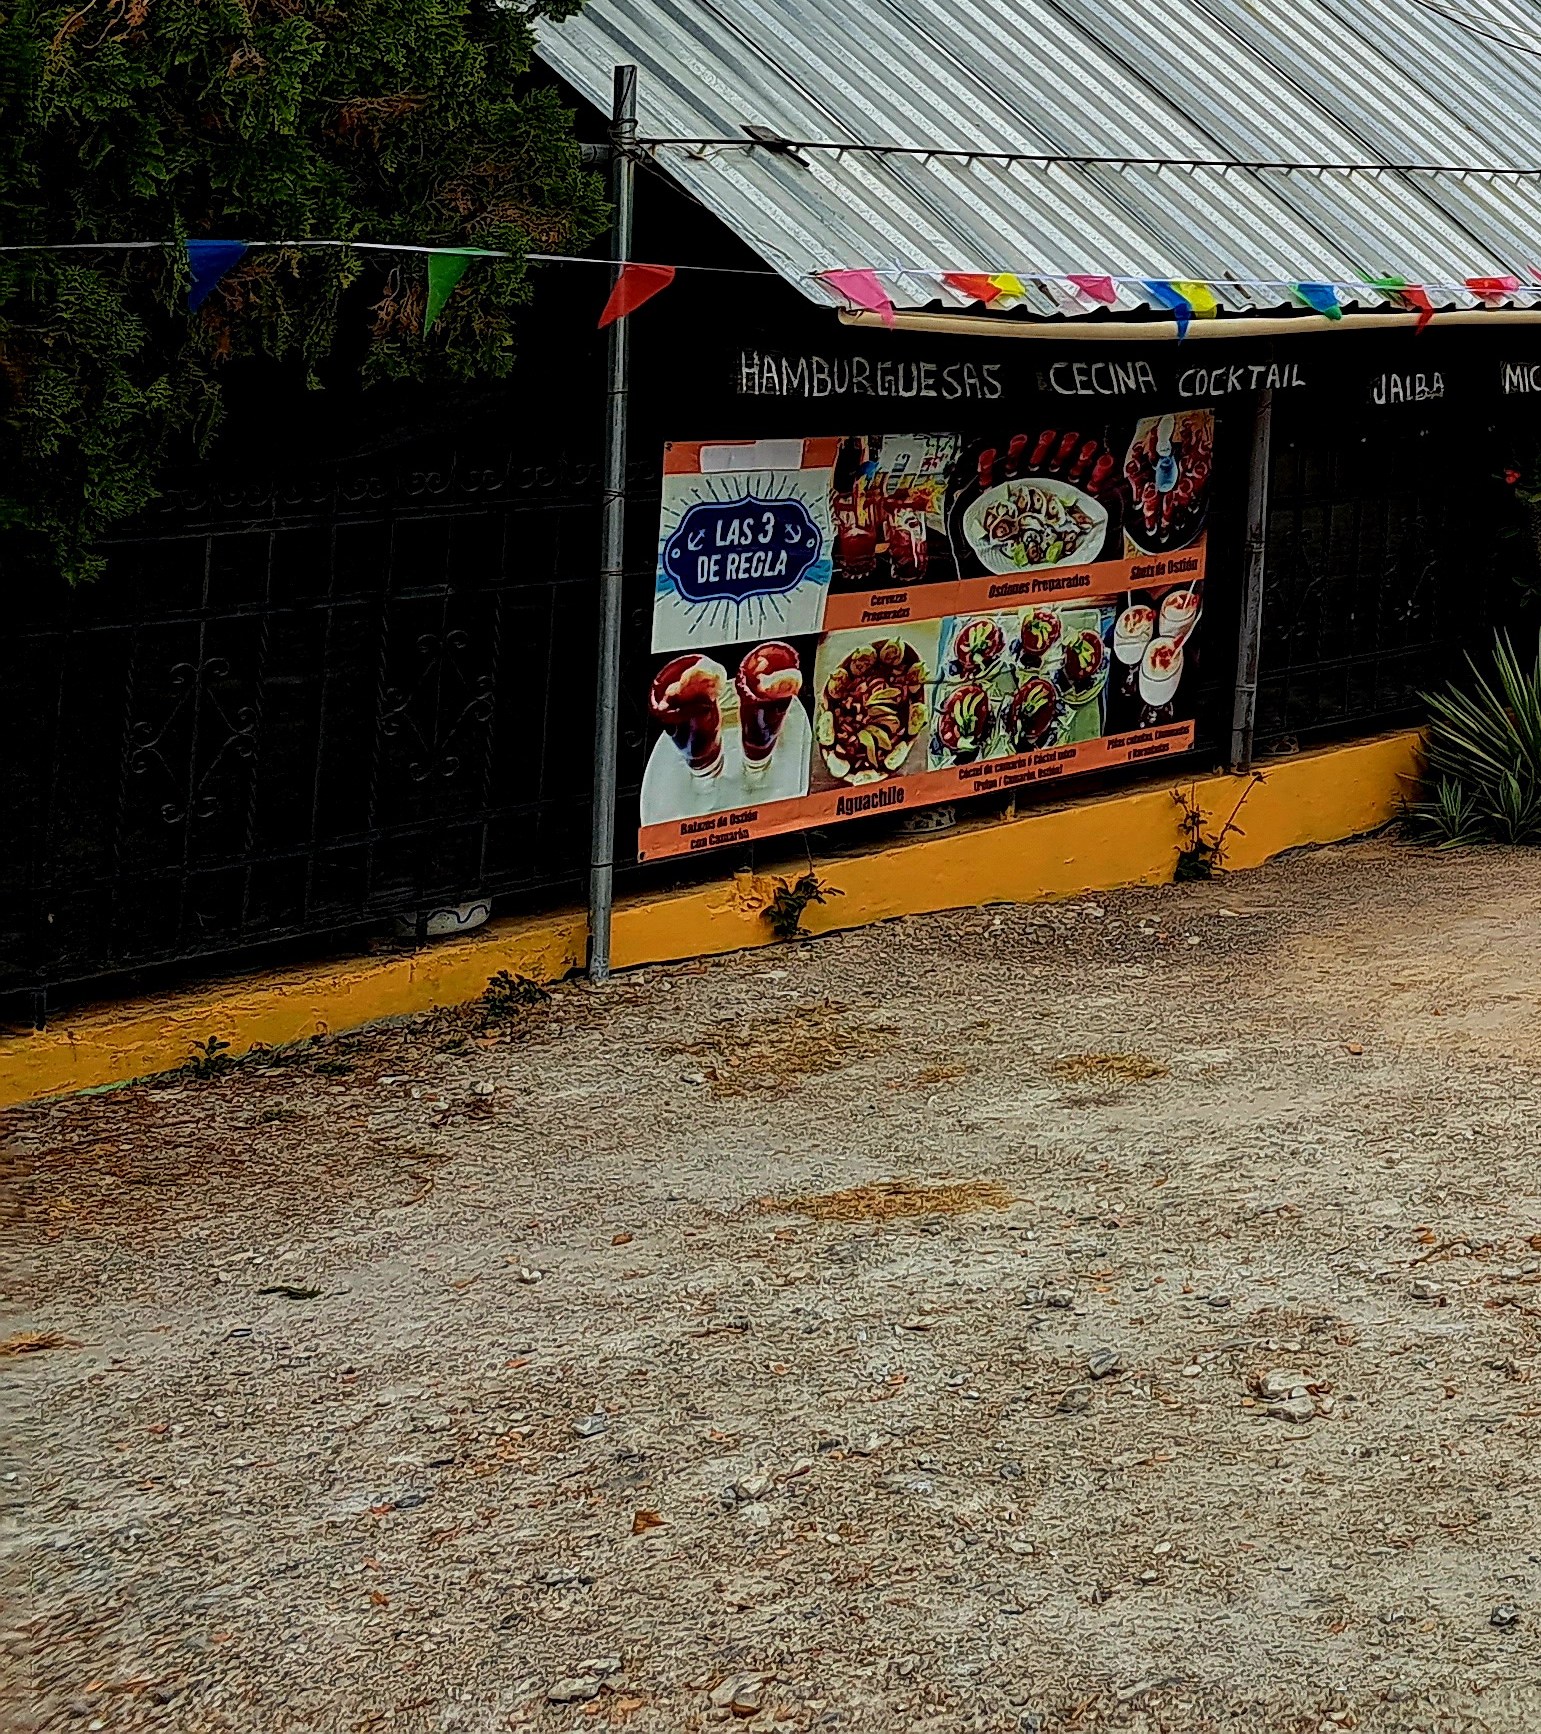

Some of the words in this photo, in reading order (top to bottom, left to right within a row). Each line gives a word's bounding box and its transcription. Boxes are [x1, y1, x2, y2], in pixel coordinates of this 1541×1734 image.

[741, 350, 1001, 399] HAMBURGUESAS
[1050, 361, 1158, 395] CECINA
[1178, 364, 1306, 397] COCKTAIL
[716, 518, 755, 546] LAS
[758, 512, 775, 543] 3
[697, 554, 721, 583] DE
[726, 549, 787, 580] REGLA
[1031, 574, 1091, 593] Preparados
[836, 785, 904, 815] Aguachile
